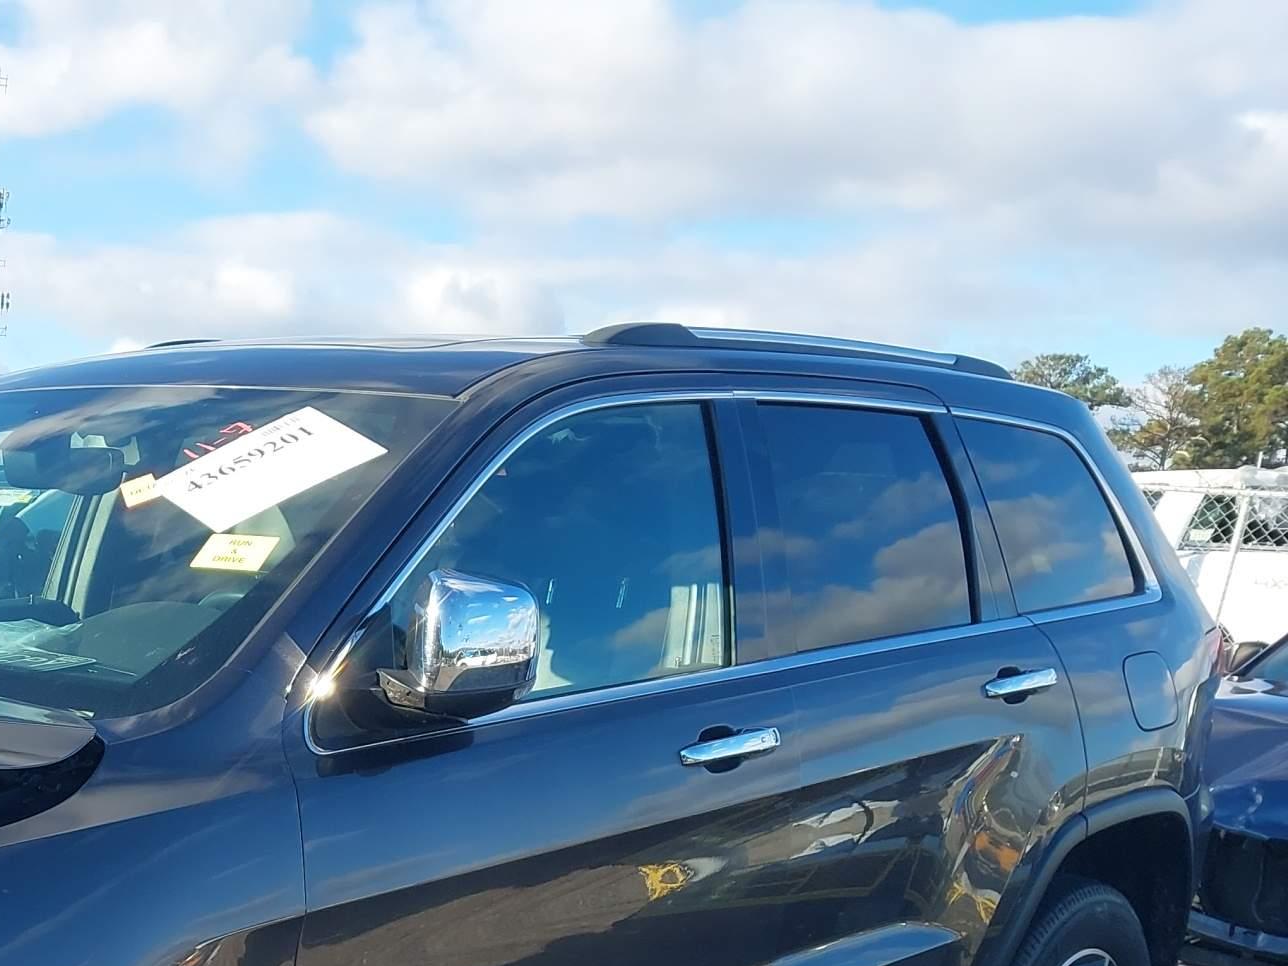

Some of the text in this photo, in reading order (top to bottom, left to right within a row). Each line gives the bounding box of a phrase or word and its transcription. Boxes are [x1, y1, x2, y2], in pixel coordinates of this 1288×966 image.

[187, 427, 315, 494] 43659201
[228, 539, 253, 547] RUN
[212, 555, 246, 564] DRIVE
